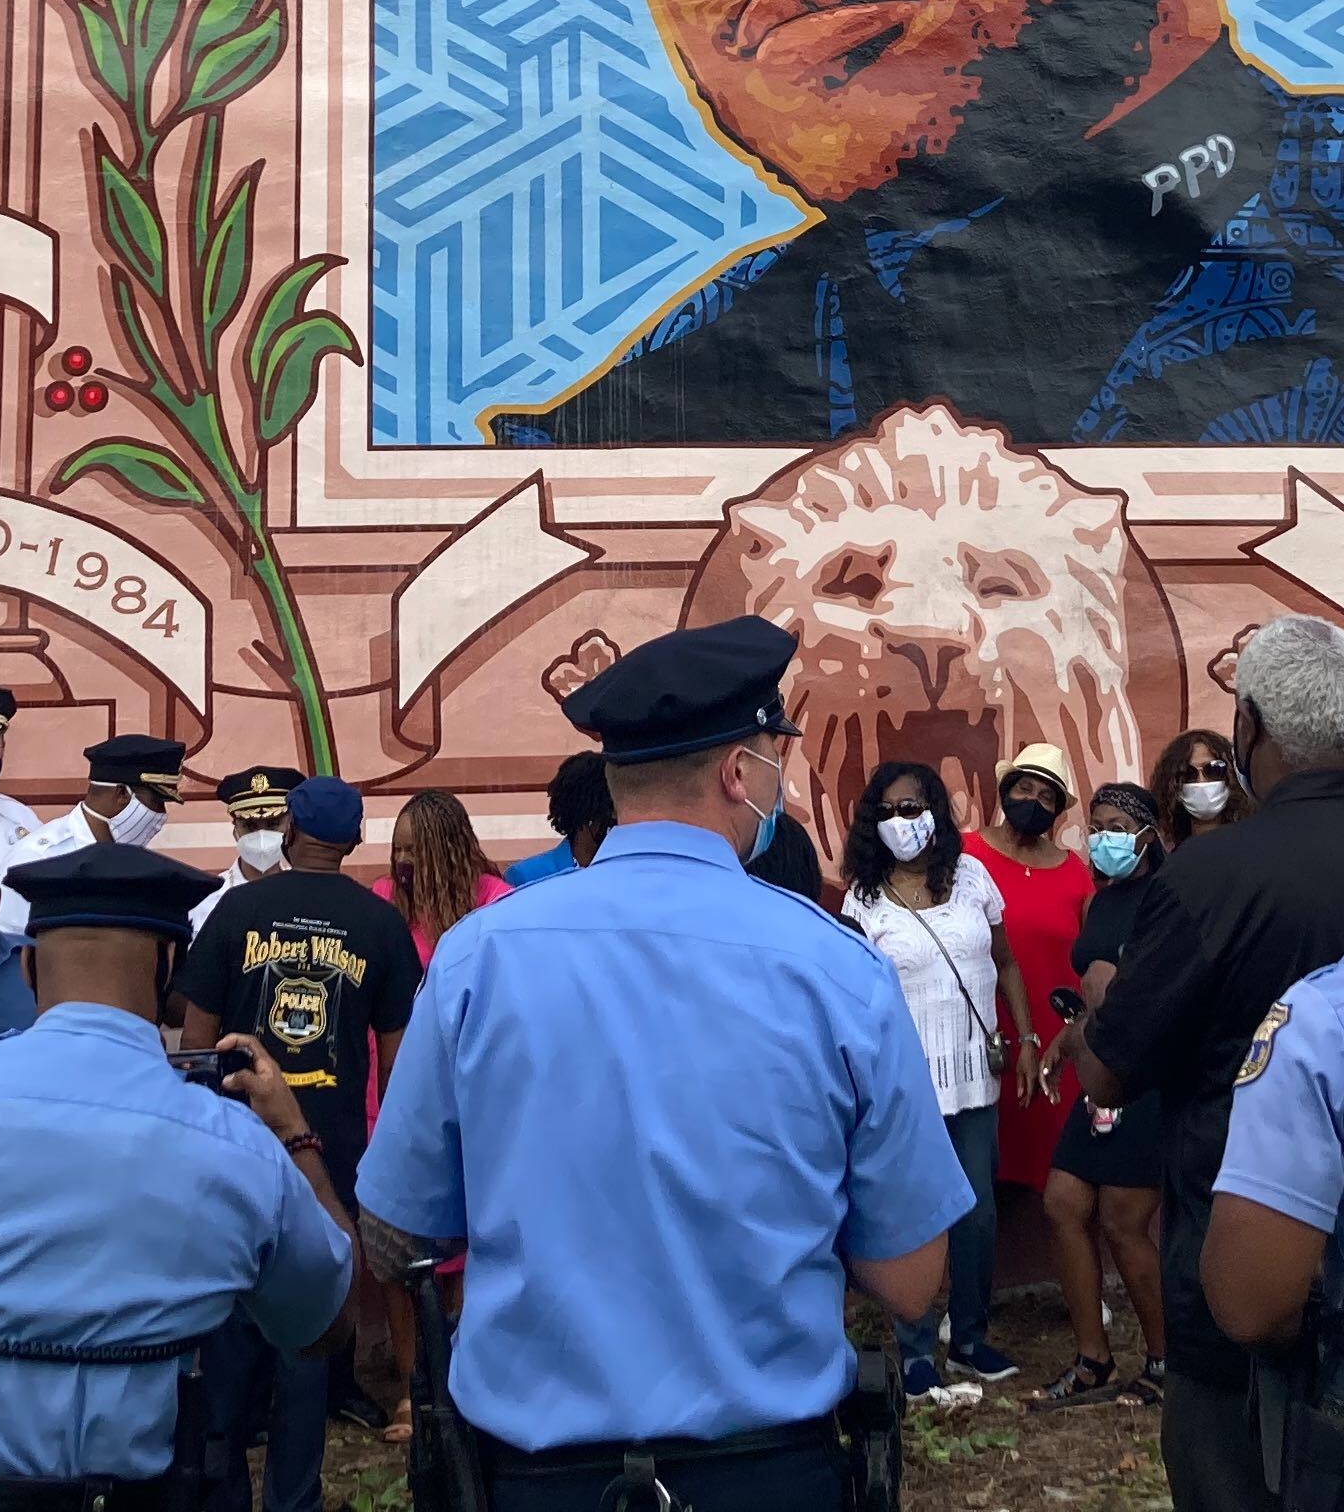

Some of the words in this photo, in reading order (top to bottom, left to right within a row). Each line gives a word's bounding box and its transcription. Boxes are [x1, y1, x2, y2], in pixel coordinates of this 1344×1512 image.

[1142, 134, 1236, 217] PPD
[243, 930, 309, 974] Robert
[311, 935, 367, 988] Wilson
[280, 992, 321, 1012] POLICE
